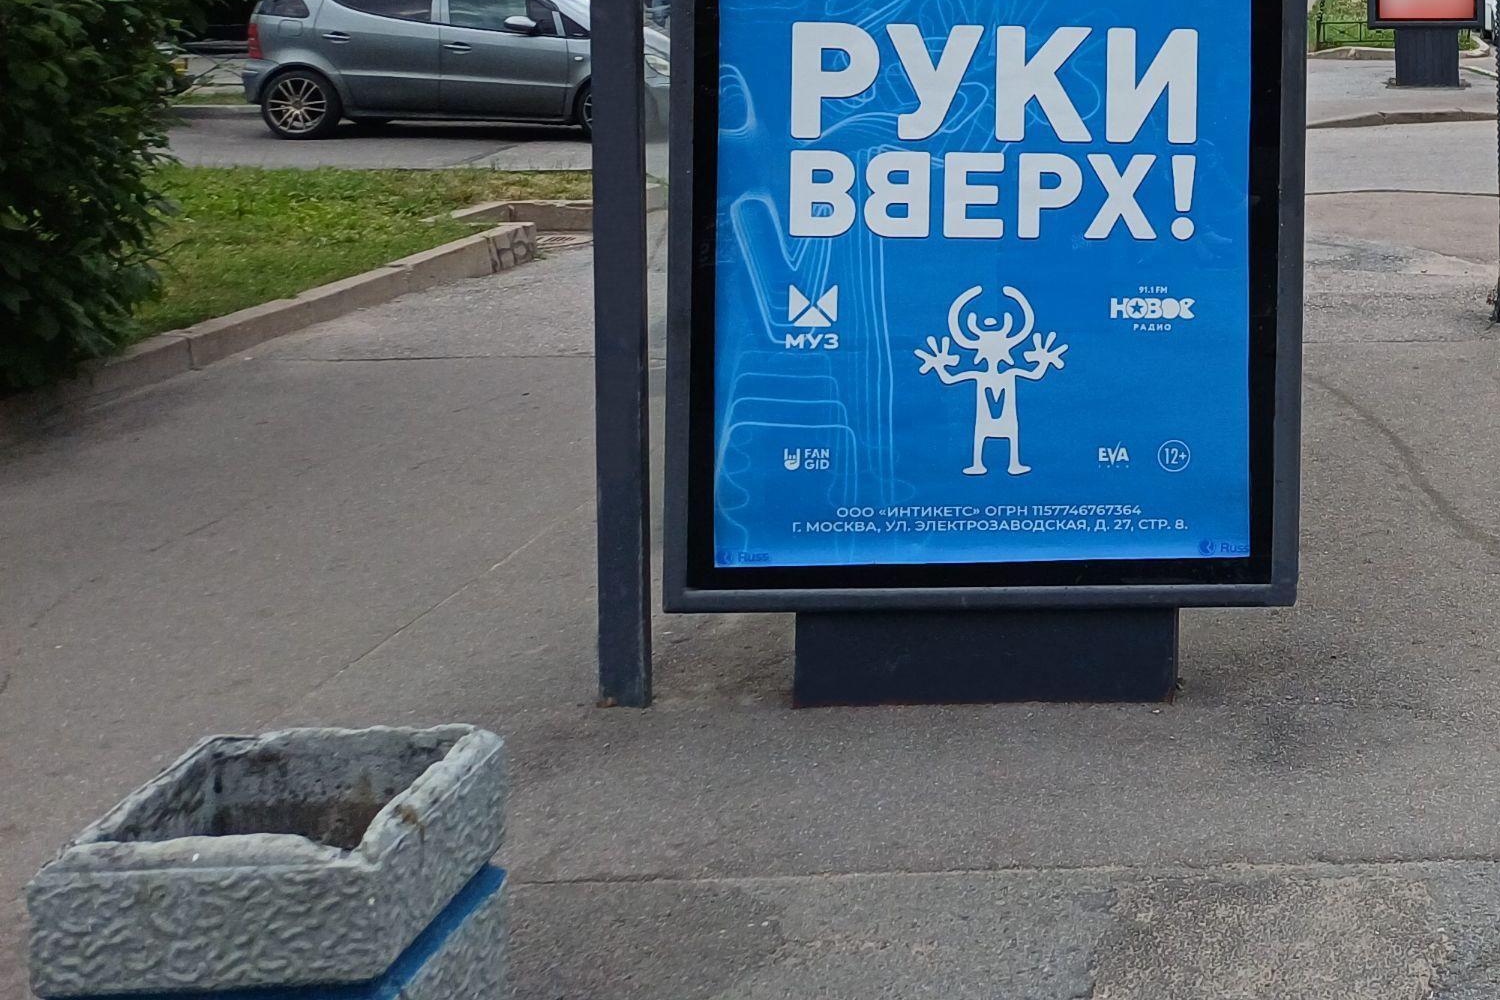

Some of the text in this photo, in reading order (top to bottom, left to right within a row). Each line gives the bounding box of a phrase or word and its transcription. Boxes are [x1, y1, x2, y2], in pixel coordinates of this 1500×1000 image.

[790, 21, 1199, 144] РУКИ
[1156, 286, 1168, 294] FM
[1133, 323, 1172, 331] РАДИО
[785, 333, 839, 349] МУЗ
[804, 448, 830, 459] FAN
[1098, 441, 1130, 466] EVA
[1164, 447, 1187, 464] 12+
[804, 459, 830, 470] GID
[836, 504, 1142, 518] ООО «ИНТИКЕТС» ОГРН 1157746767364
[792, 518, 1189, 533] Г. МОСКВА, УЛ. ЭЛЕКТРОЗАВОДСКАЯ, Д. 27, СТР. 8.
